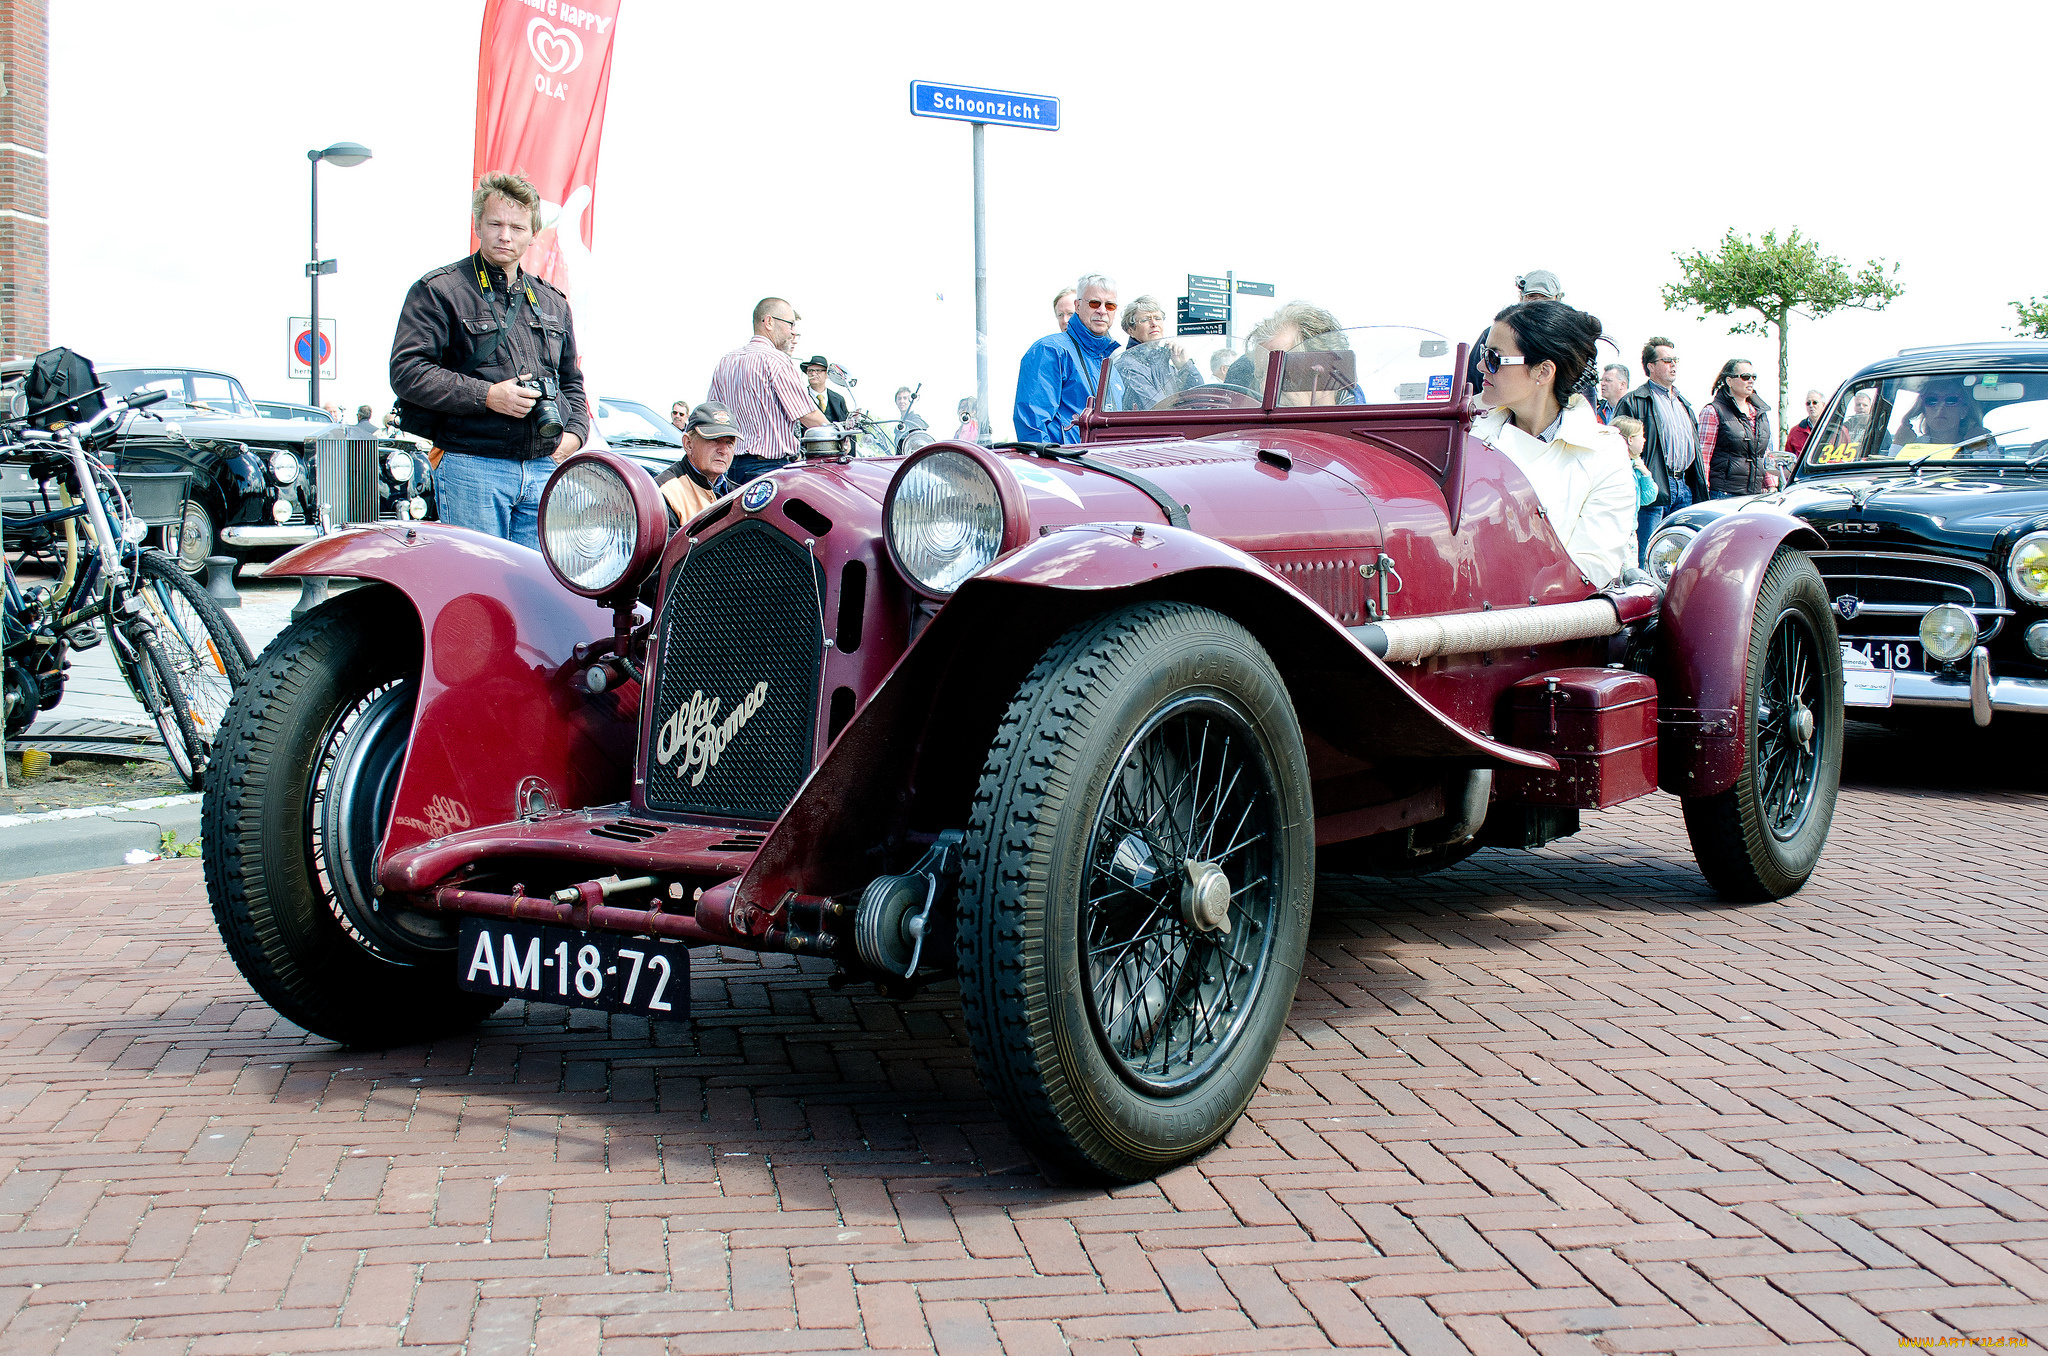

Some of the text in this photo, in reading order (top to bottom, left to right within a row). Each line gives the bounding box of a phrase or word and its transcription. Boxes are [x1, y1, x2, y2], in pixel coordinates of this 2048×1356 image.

[933, 92, 1040, 120] Schoonzicht
[1818, 443, 1858, 464] 345
[1827, 522, 1880, 534] 403
[1166, 652, 1266, 704] MICHELIN
[467, 930, 672, 1012] AM-18-72
[1128, 1087, 1233, 1142] MICHELIN
